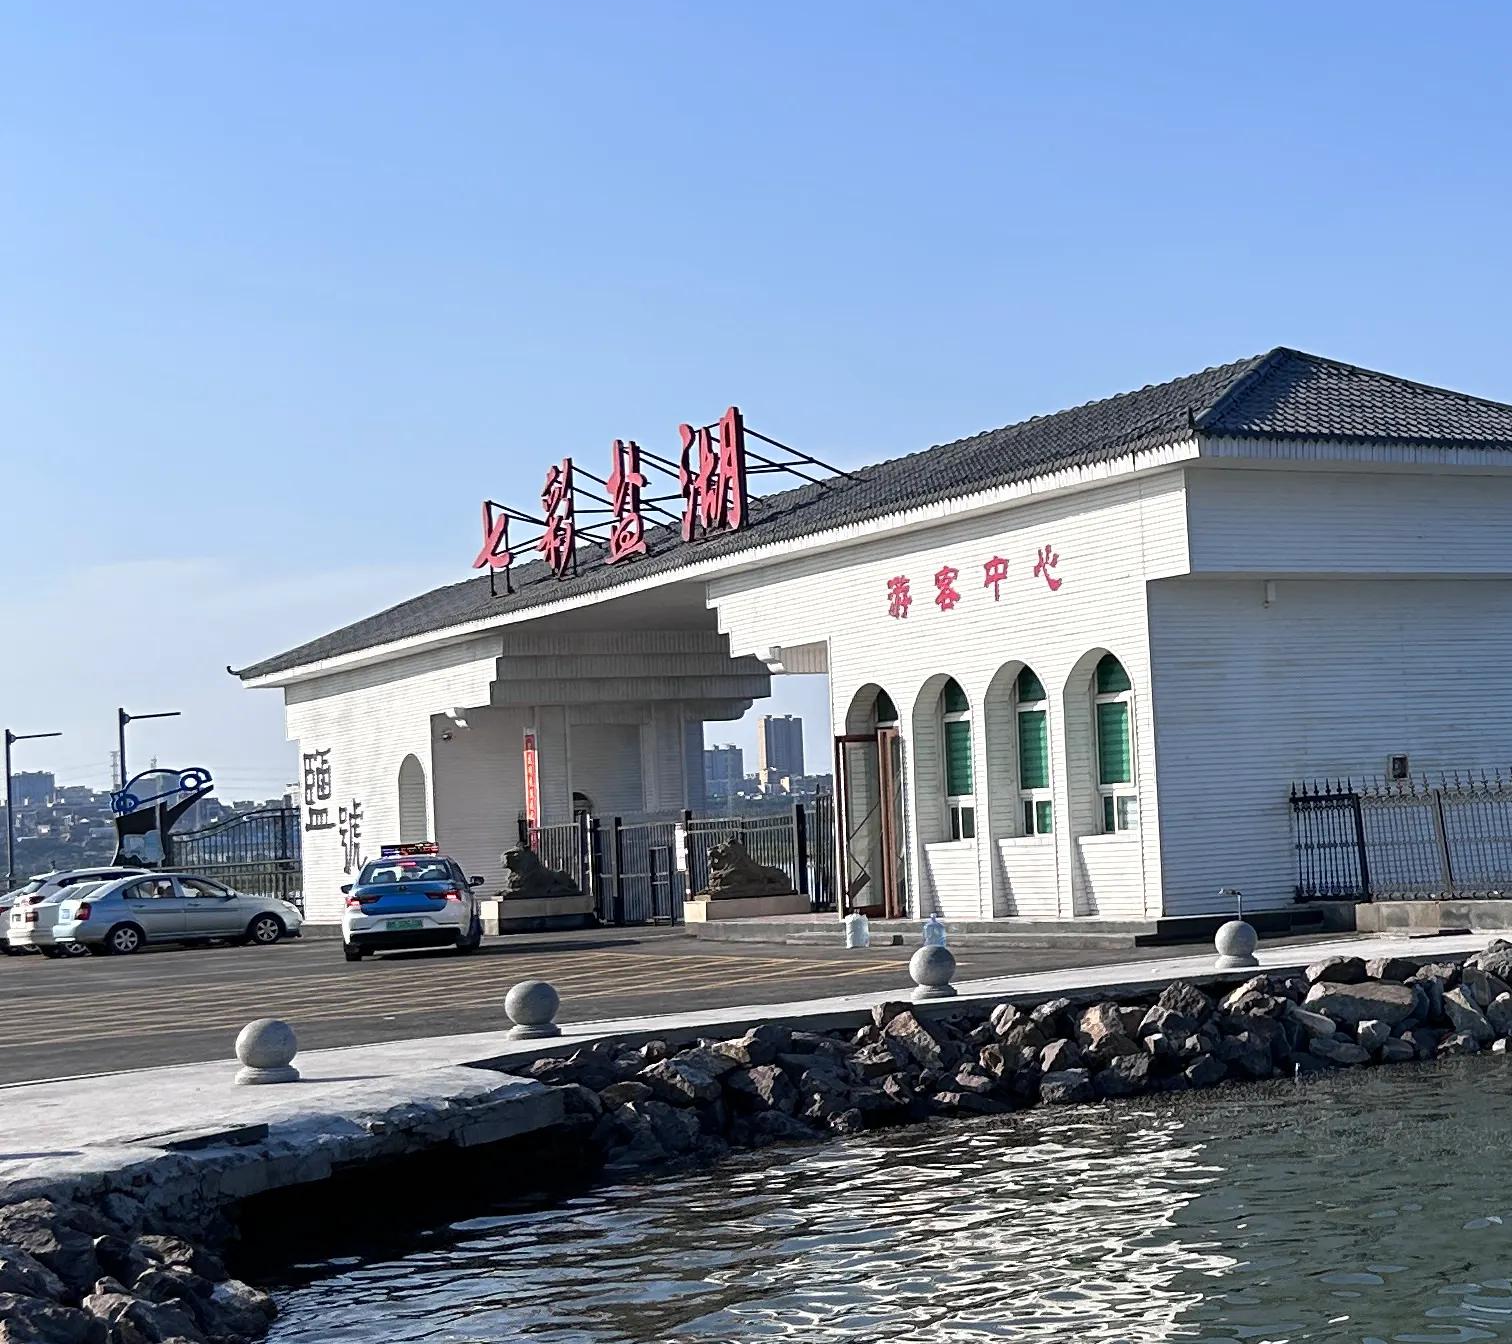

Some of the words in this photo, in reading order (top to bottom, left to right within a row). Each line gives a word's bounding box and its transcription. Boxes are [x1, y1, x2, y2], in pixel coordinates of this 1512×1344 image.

[472, 406, 744, 579] 七彩盐湖
[886, 544, 1063, 620] 游客中心
